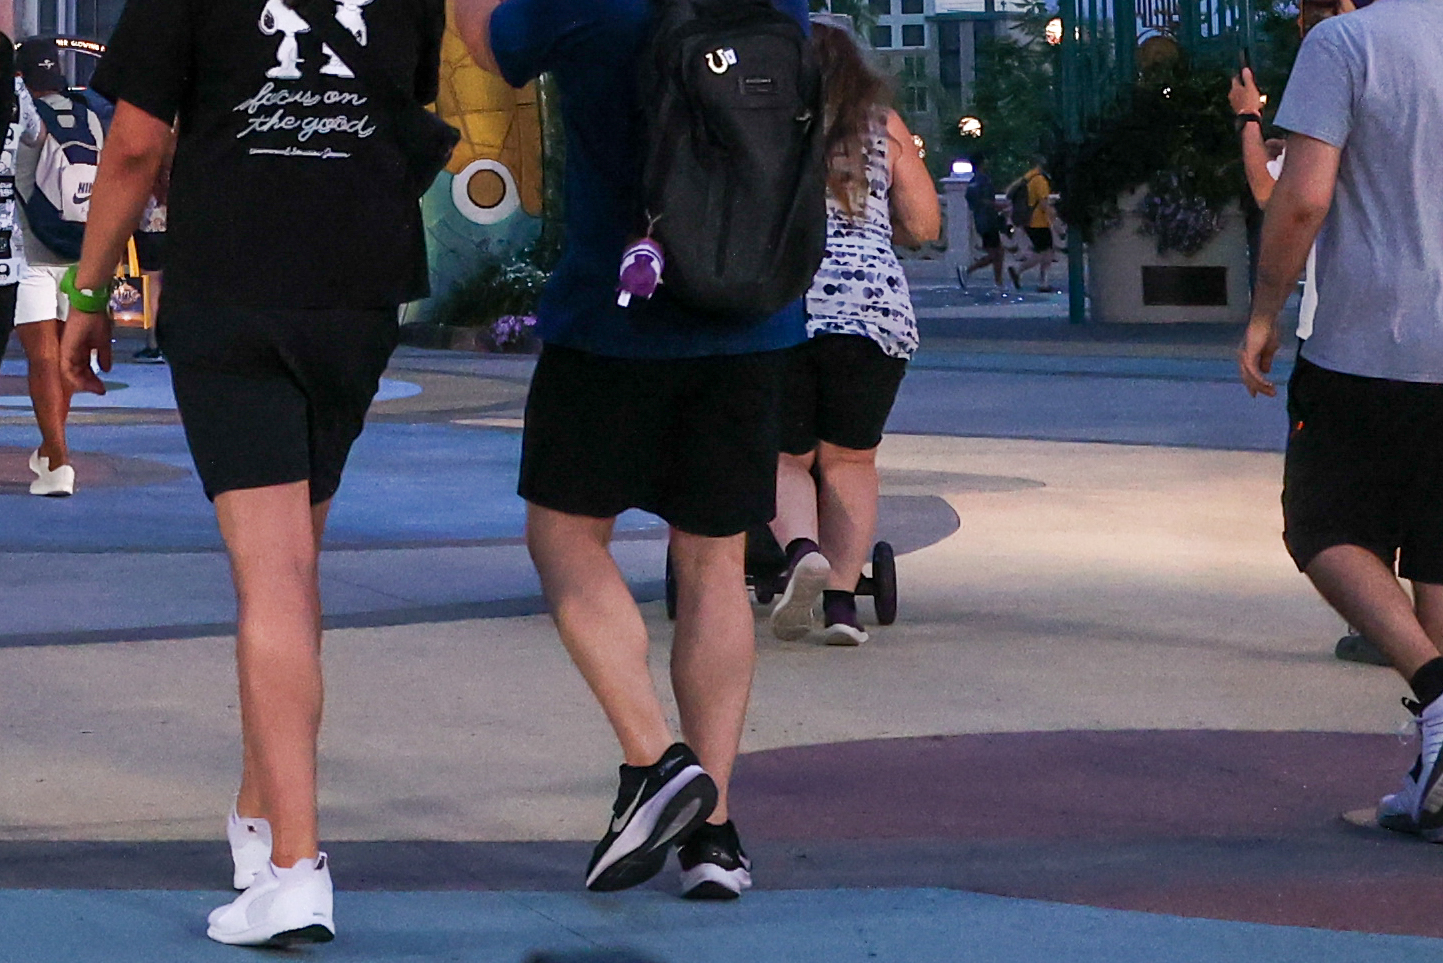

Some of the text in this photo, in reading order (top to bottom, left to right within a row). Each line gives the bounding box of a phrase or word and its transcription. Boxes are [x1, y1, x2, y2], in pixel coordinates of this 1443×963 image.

[233, 82, 367, 113] focus on
[236, 109, 376, 142] the good
